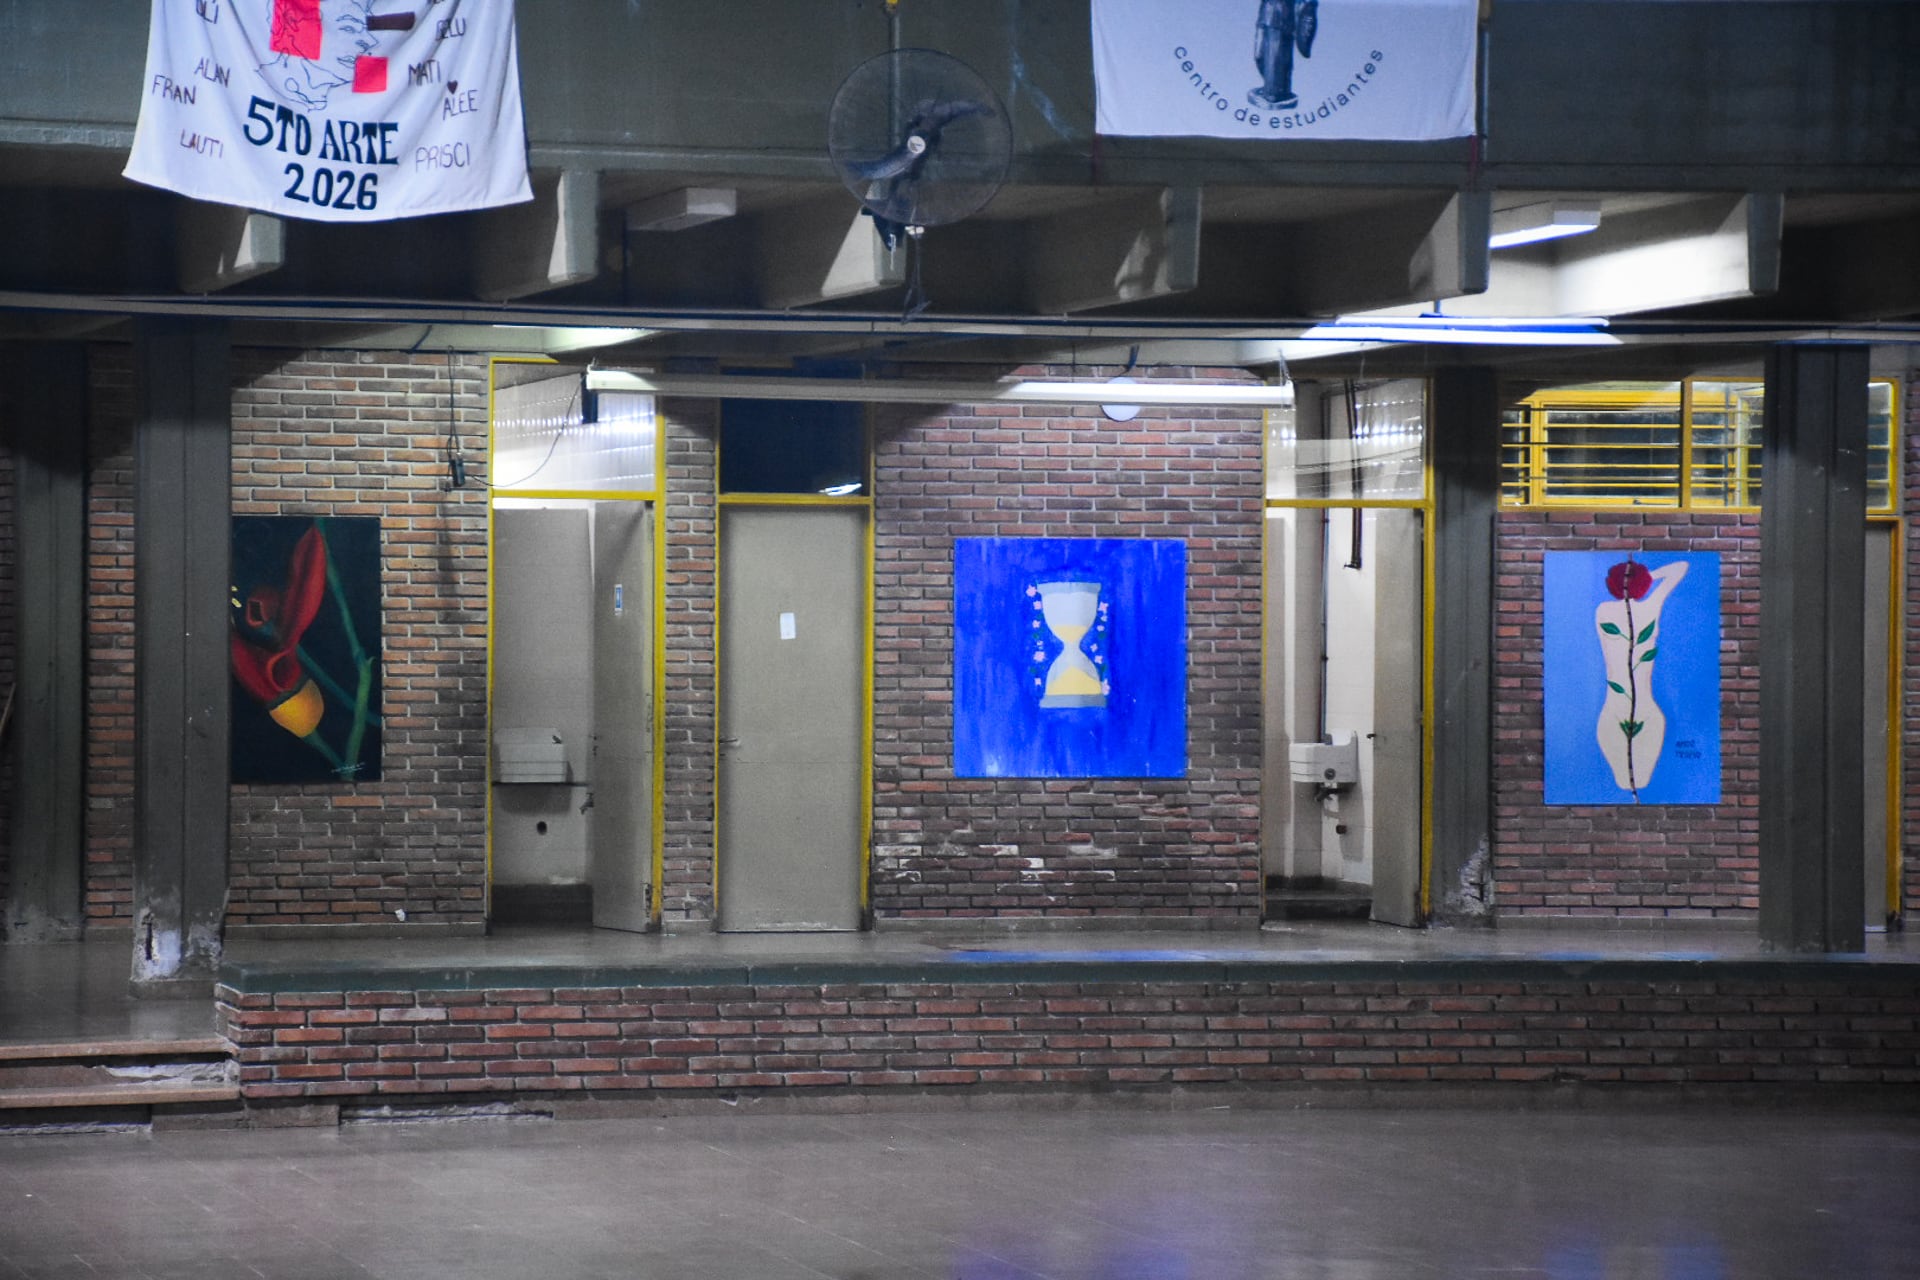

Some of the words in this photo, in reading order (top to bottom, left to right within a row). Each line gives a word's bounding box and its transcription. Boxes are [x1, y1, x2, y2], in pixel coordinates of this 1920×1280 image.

[193, 57, 231, 88] ALAN
[408, 59, 441, 87] MATI
[1174, 45, 1230, 112] centro
[1234, 107, 1261, 127] de
[1269, 48, 1383, 129] estudiantes
[152, 74, 196, 105] FRAN
[442, 89, 479, 121] ALEE
[180, 128, 224, 159] LAUTI
[318, 118, 399, 165] ARTE
[415, 142, 470, 173] PRISCI
[284, 162, 379, 211] 2026
